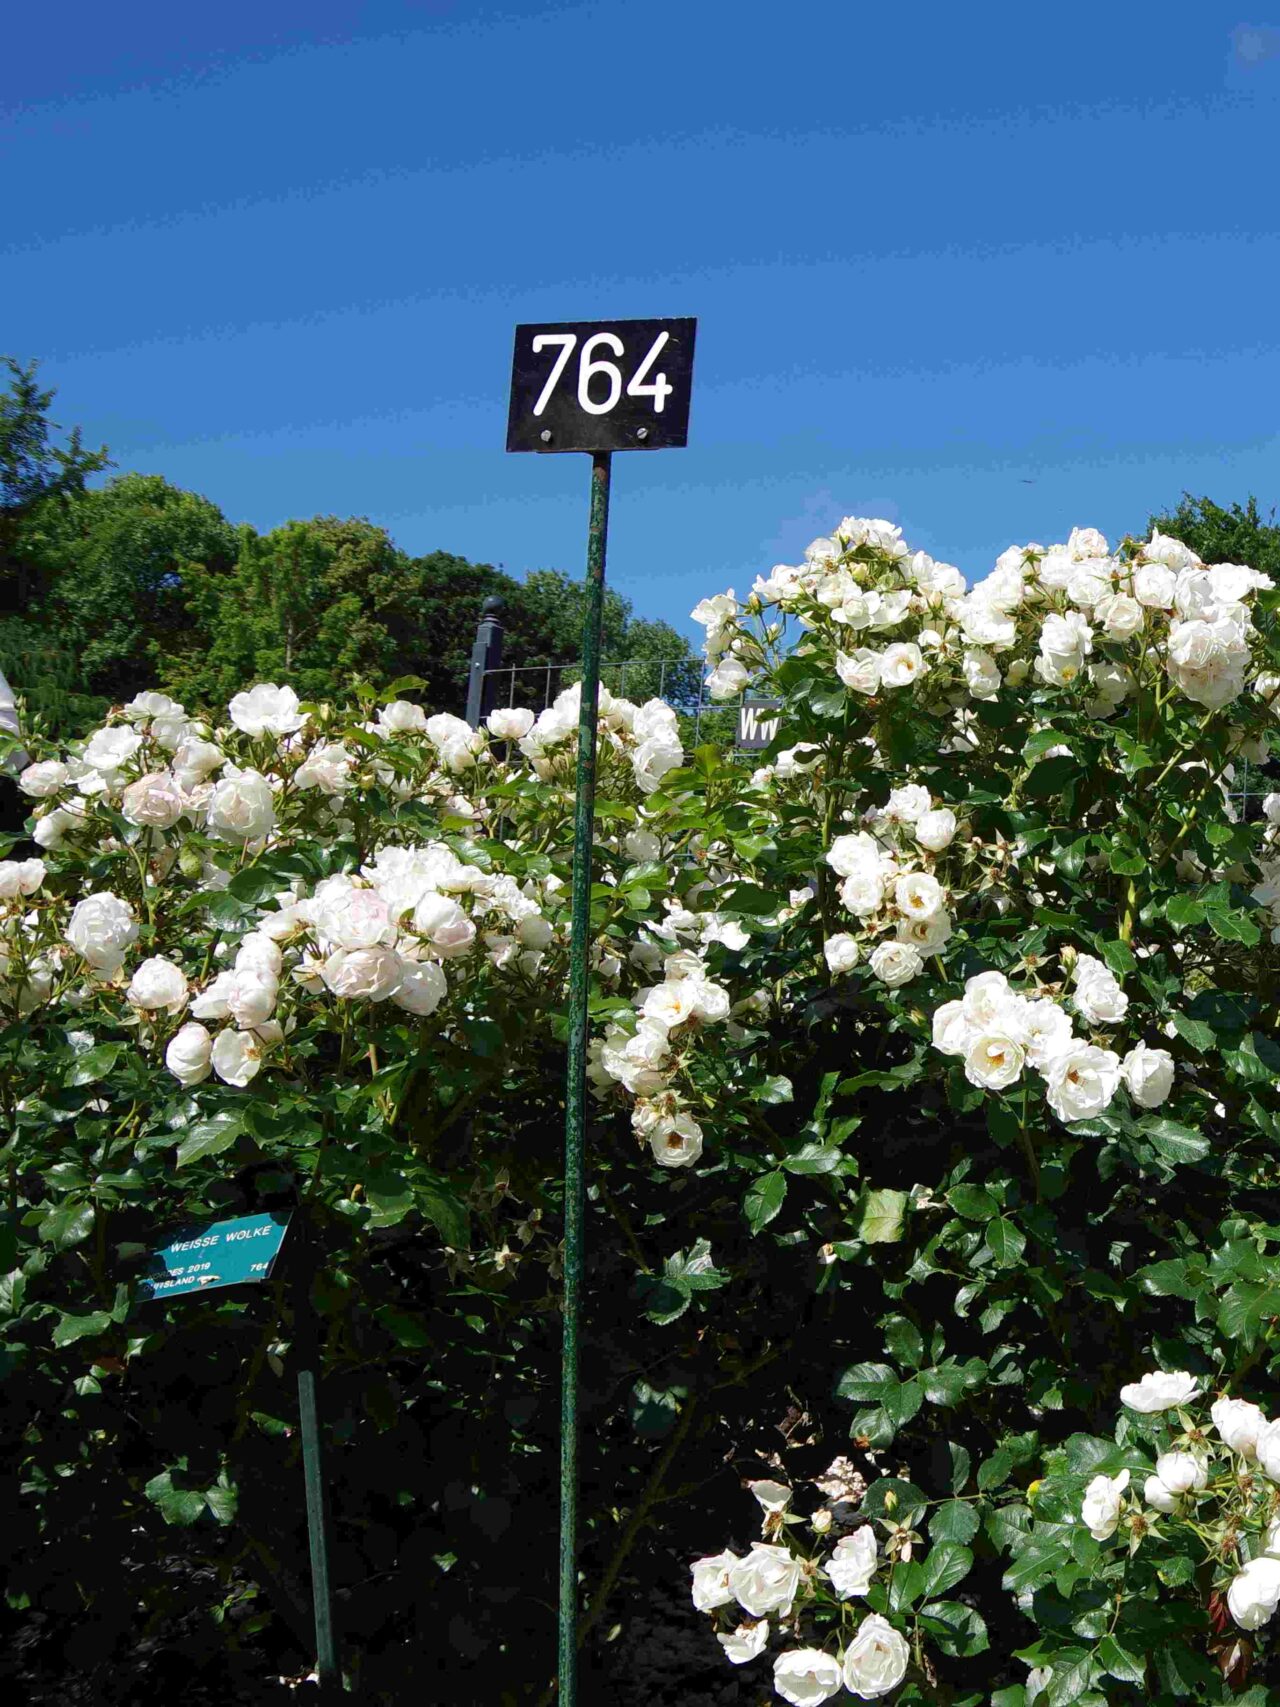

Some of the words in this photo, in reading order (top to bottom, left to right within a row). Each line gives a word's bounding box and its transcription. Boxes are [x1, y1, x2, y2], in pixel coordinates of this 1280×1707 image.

[532, 331, 673, 416] 764
[171, 1235, 220, 1253] WEISSE
[226, 1225, 272, 1242] WOLKE
[187, 1261, 212, 1274] 2019
[249, 1261, 270, 1273] 764
